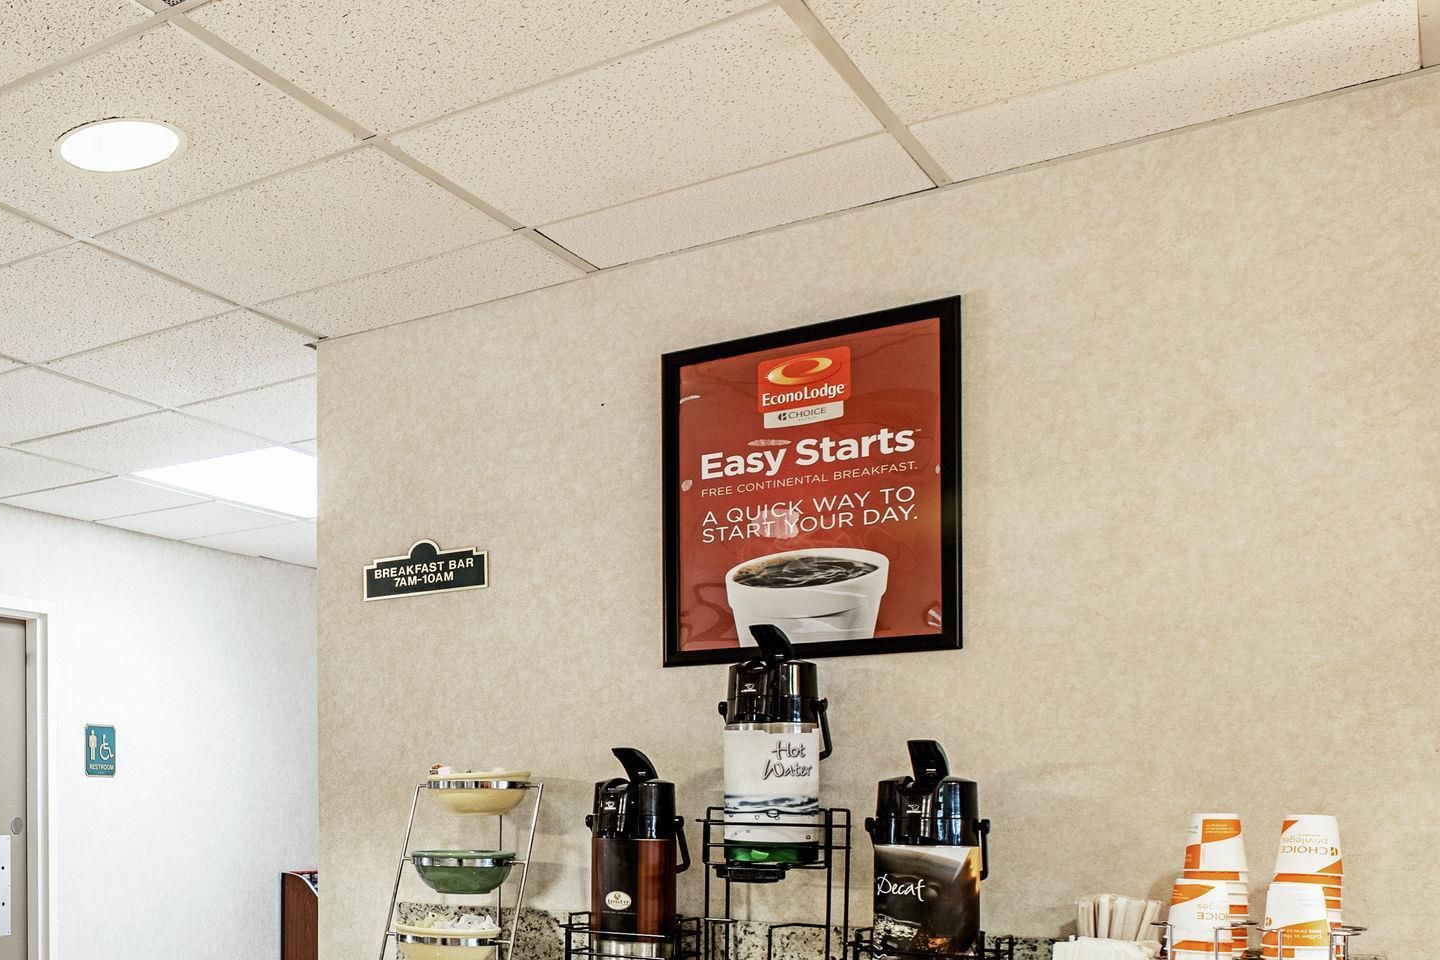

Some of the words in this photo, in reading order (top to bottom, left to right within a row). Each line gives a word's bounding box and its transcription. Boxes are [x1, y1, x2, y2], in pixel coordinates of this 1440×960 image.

[762, 383, 845, 407] EconoLodge
[788, 406, 827, 419] CHOICE
[701, 447, 787, 480] Easy
[701, 484, 733, 498] FREE
[736, 474, 830, 493] CONTINENTAL
[833, 461, 918, 481] BREAKFAST.
[702, 510, 717, 526] A
[726, 500, 804, 524] QUICK
[812, 492, 871, 511] WAY
[880, 485, 915, 504] TO
[702, 520, 775, 543] START
[784, 513, 854, 534] YOUR
[863, 505, 918, 526] DAY.
[374, 562, 445, 579] BREAKFAST
[449, 557, 474, 570] BAR
[394, 571, 454, 587] 7AM-10AM
[771, 741, 806, 760] Hot
[762, 759, 813, 780] Water
[1280, 845, 1328, 855] CHOICE
[876, 873, 926, 901] Decaf
